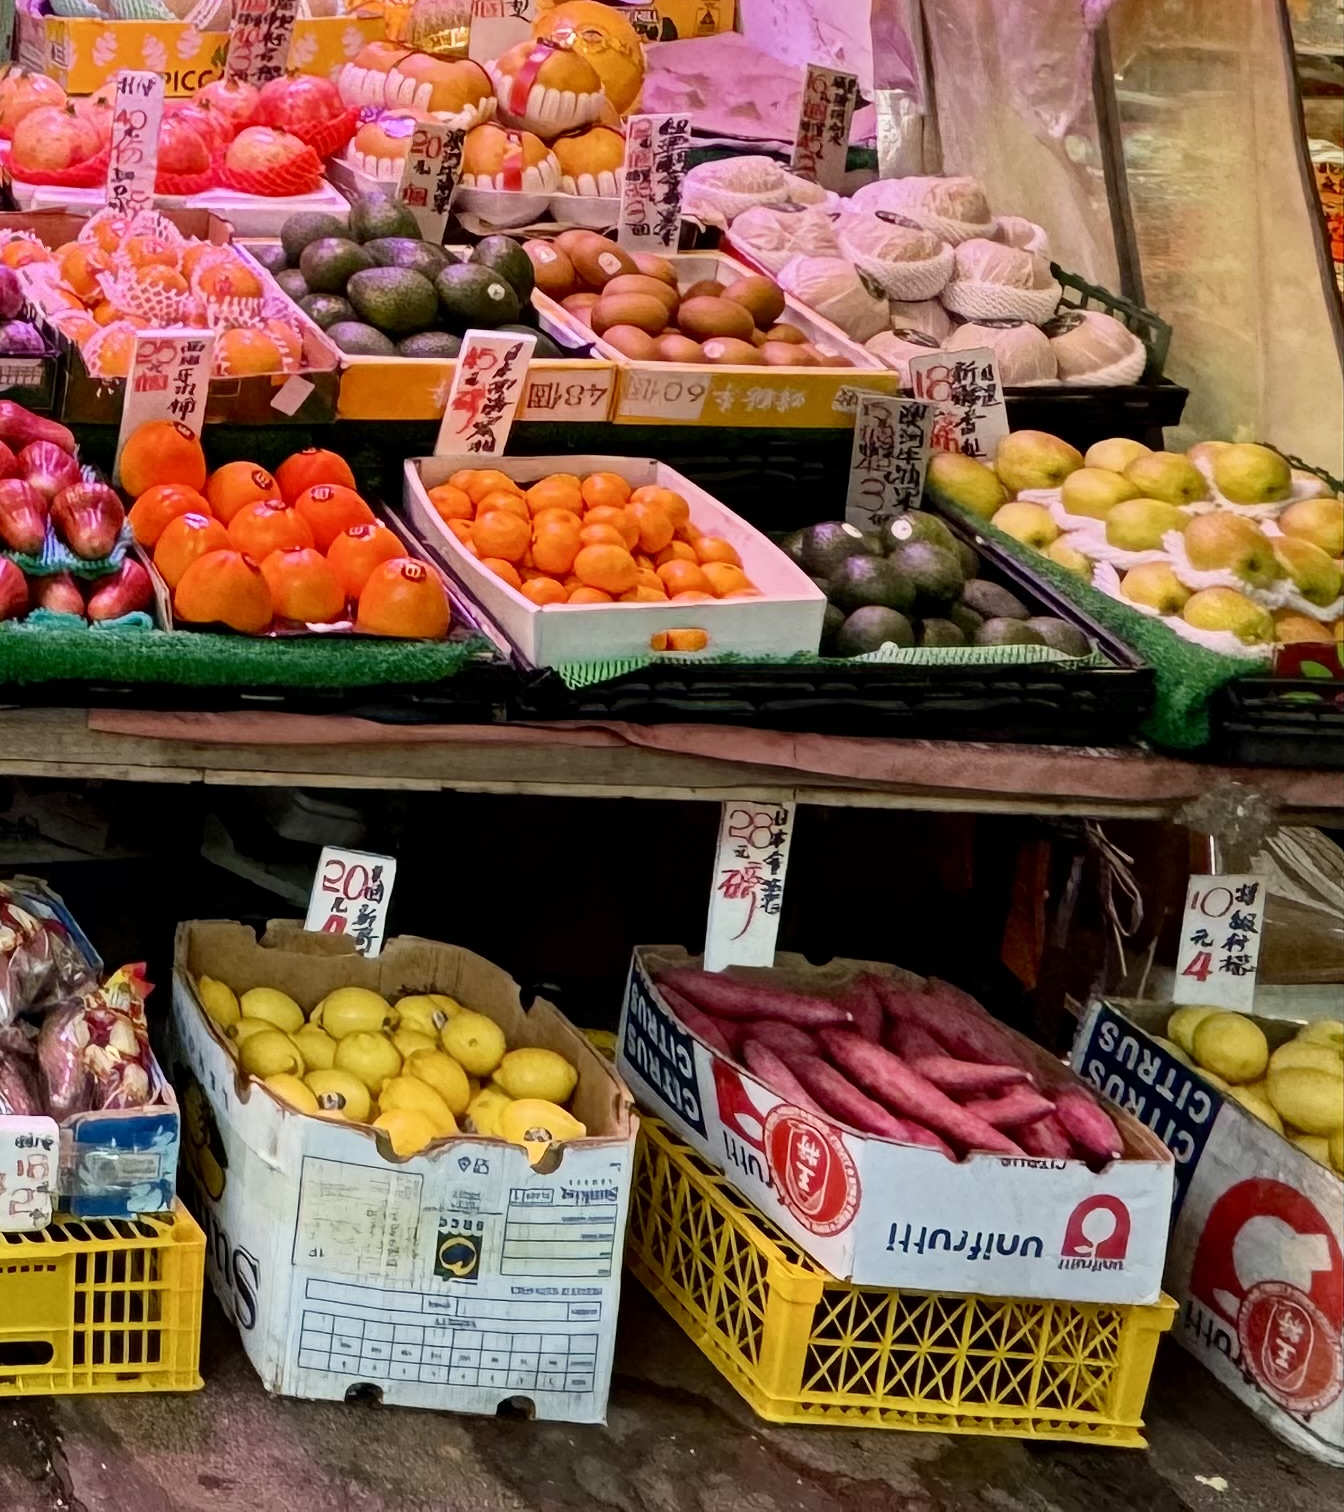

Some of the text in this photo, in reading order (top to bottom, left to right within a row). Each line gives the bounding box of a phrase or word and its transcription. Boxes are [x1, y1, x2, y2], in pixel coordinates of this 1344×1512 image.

[915, 364, 953, 402] 18
[728, 808, 774, 850] 28
[321, 858, 369, 901] 20
[1190, 886, 1235, 919] 10
[1180, 950, 1214, 983] 4
[627, 1021, 701, 1123] CITRUS
[1097, 1020, 1213, 1125] CITRUS
[885, 1222, 1044, 1261] unifrutti
